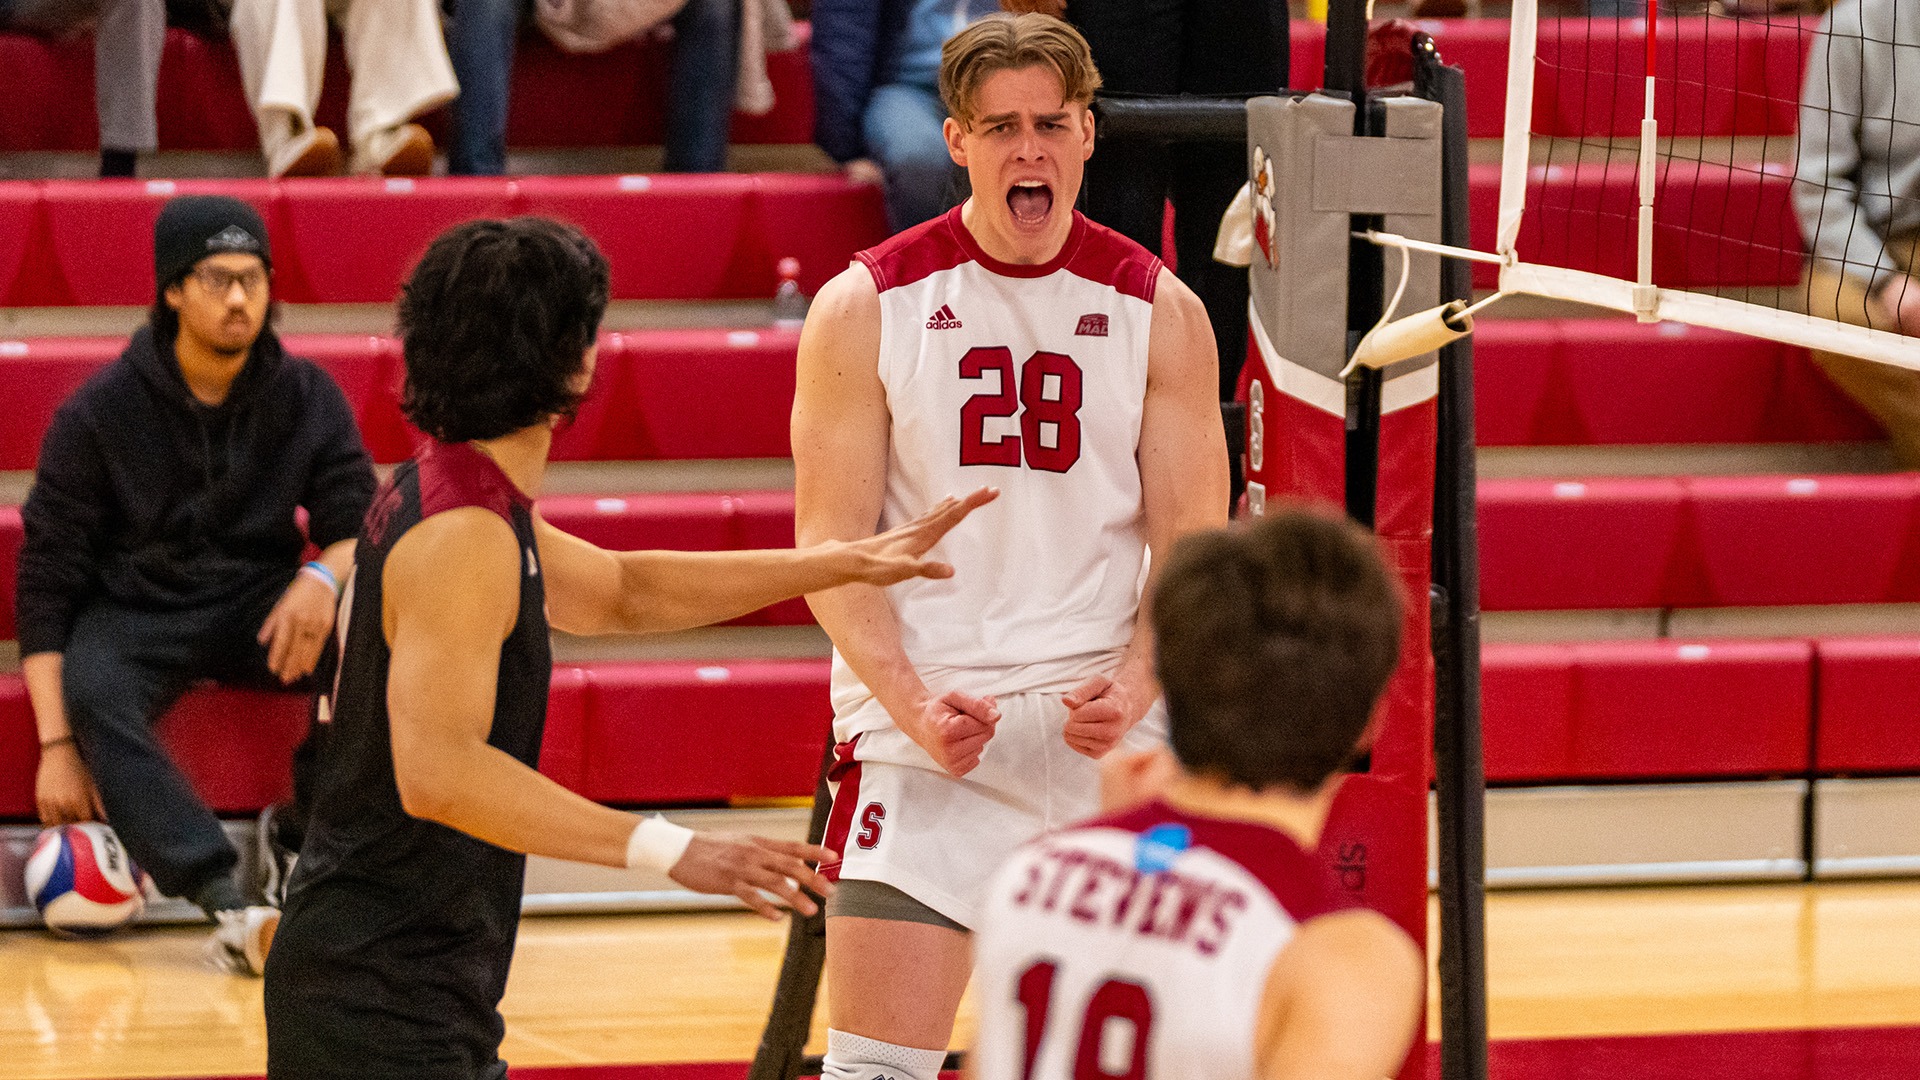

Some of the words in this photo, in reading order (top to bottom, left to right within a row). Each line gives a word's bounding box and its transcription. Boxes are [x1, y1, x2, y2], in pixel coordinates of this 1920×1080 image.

[926, 319, 963, 330] adidas
[959, 346, 1083, 473] 28
[856, 801, 887, 850] S
[1012, 849, 1246, 955] STEVENS
